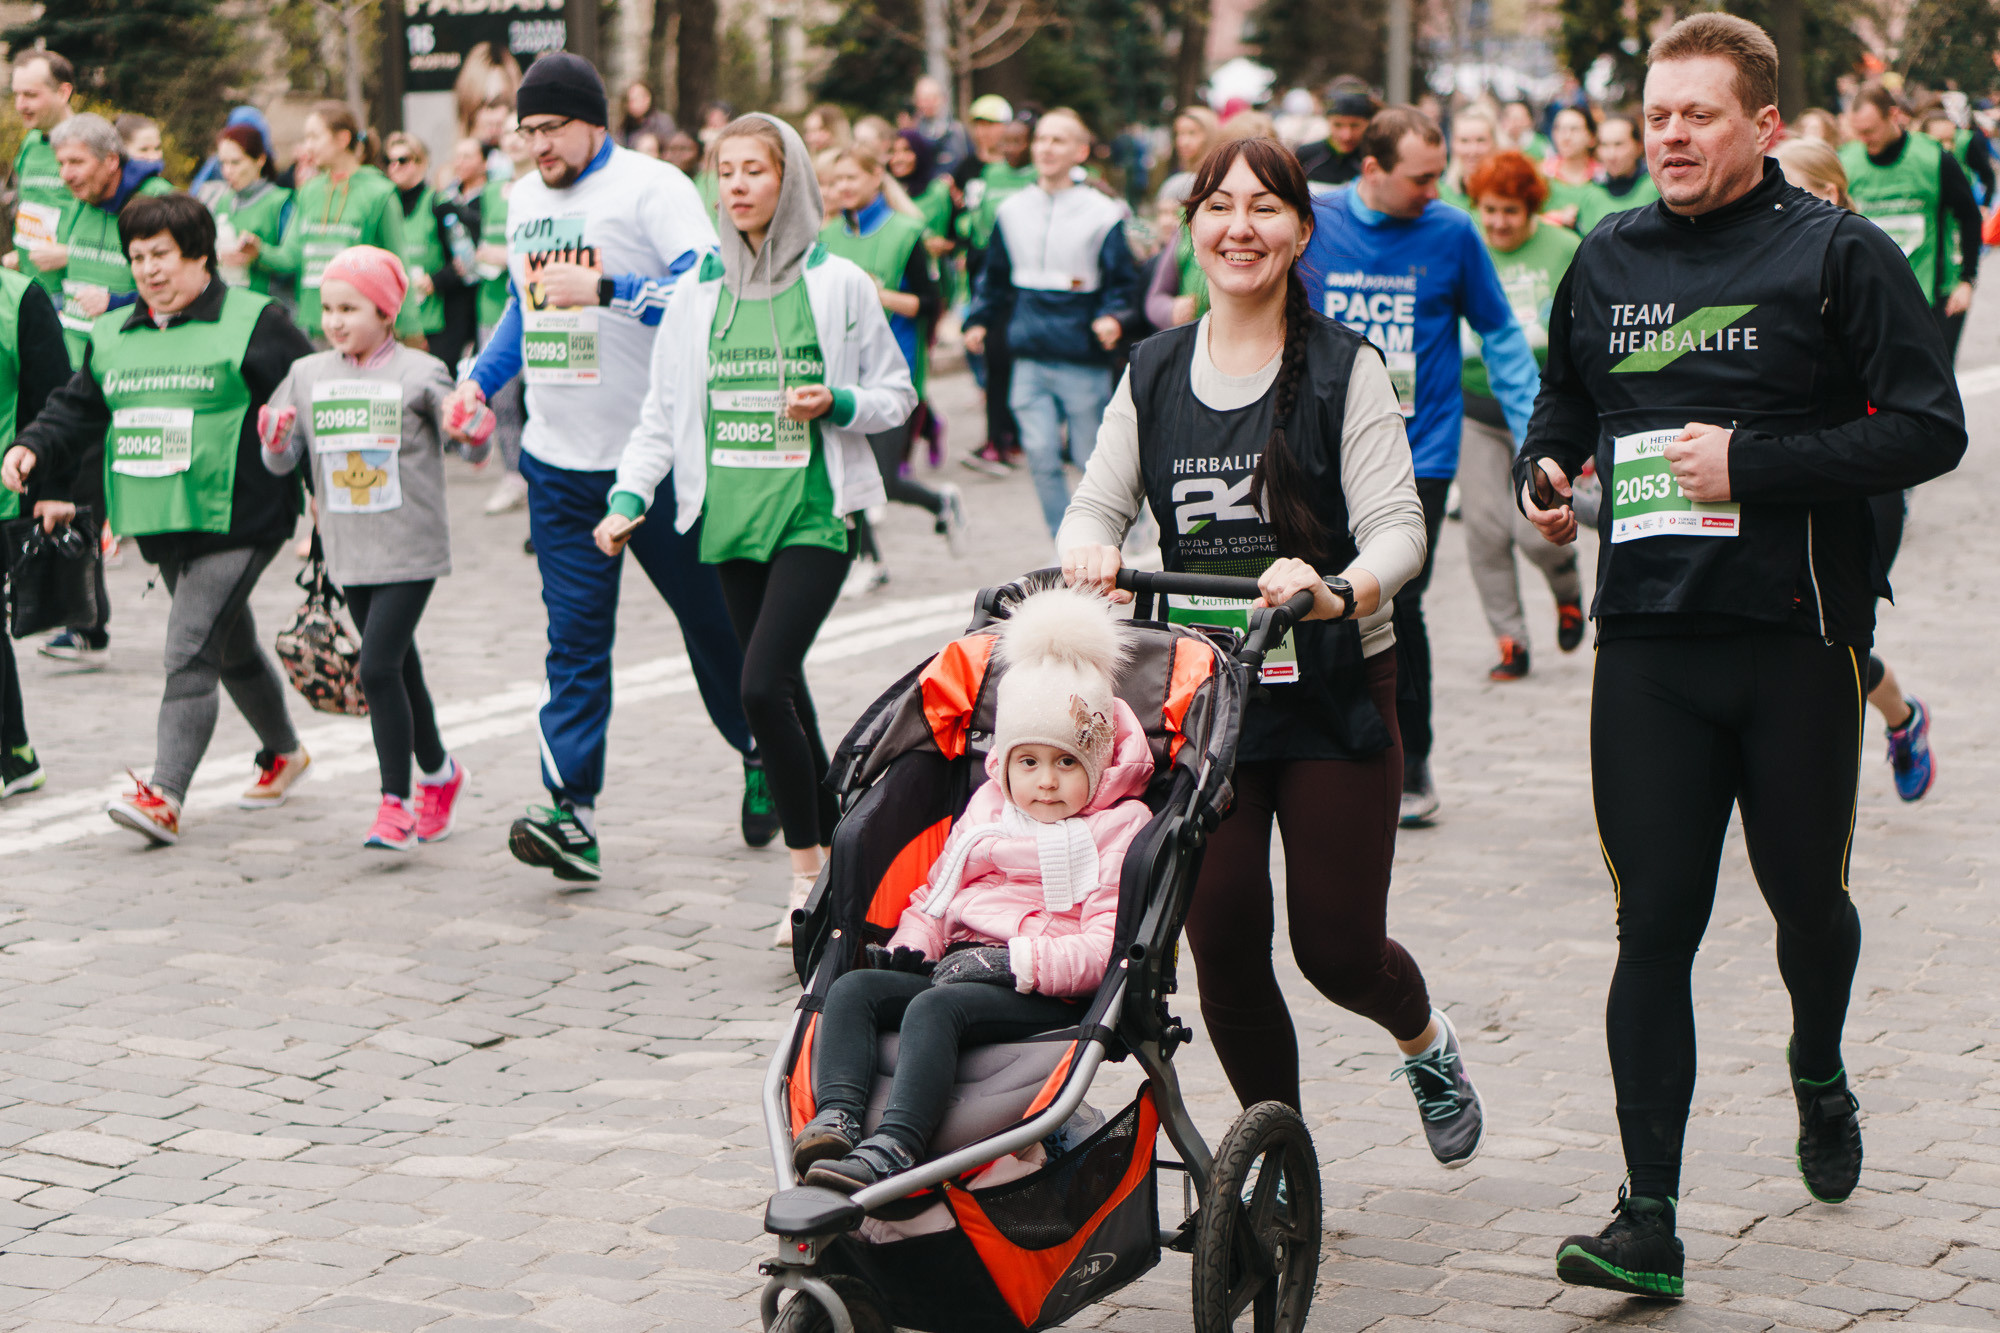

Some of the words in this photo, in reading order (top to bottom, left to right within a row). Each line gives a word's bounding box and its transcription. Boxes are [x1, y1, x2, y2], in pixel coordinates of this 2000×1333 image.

[528, 236, 595, 272] with
[1323, 291, 1416, 325] PACE
[1610, 302, 1676, 326] TEAM
[1608, 327, 1759, 354] HERBALIFE
[526, 341, 568, 362] 20993
[719, 346, 818, 360] HERBALIF
[119, 374, 215, 394] NUTRITION
[315, 407, 368, 430] 20982
[778, 420, 804, 431] RUN
[716, 421, 774, 442] 20082
[117, 435, 162, 456] 20042
[1173, 453, 1263, 474] HERBALIF
[1178, 540, 1210, 548] БУДЬ
[1214, 538, 1223, 546] В
[1228, 534, 1278, 546] СВОЕЙ
[1181, 547, 1228, 556] ЛУЧШЕЙ
[1231, 544, 1278, 554] ФОРМЕ
[1202, 597, 1253, 606] NUTRITIO
